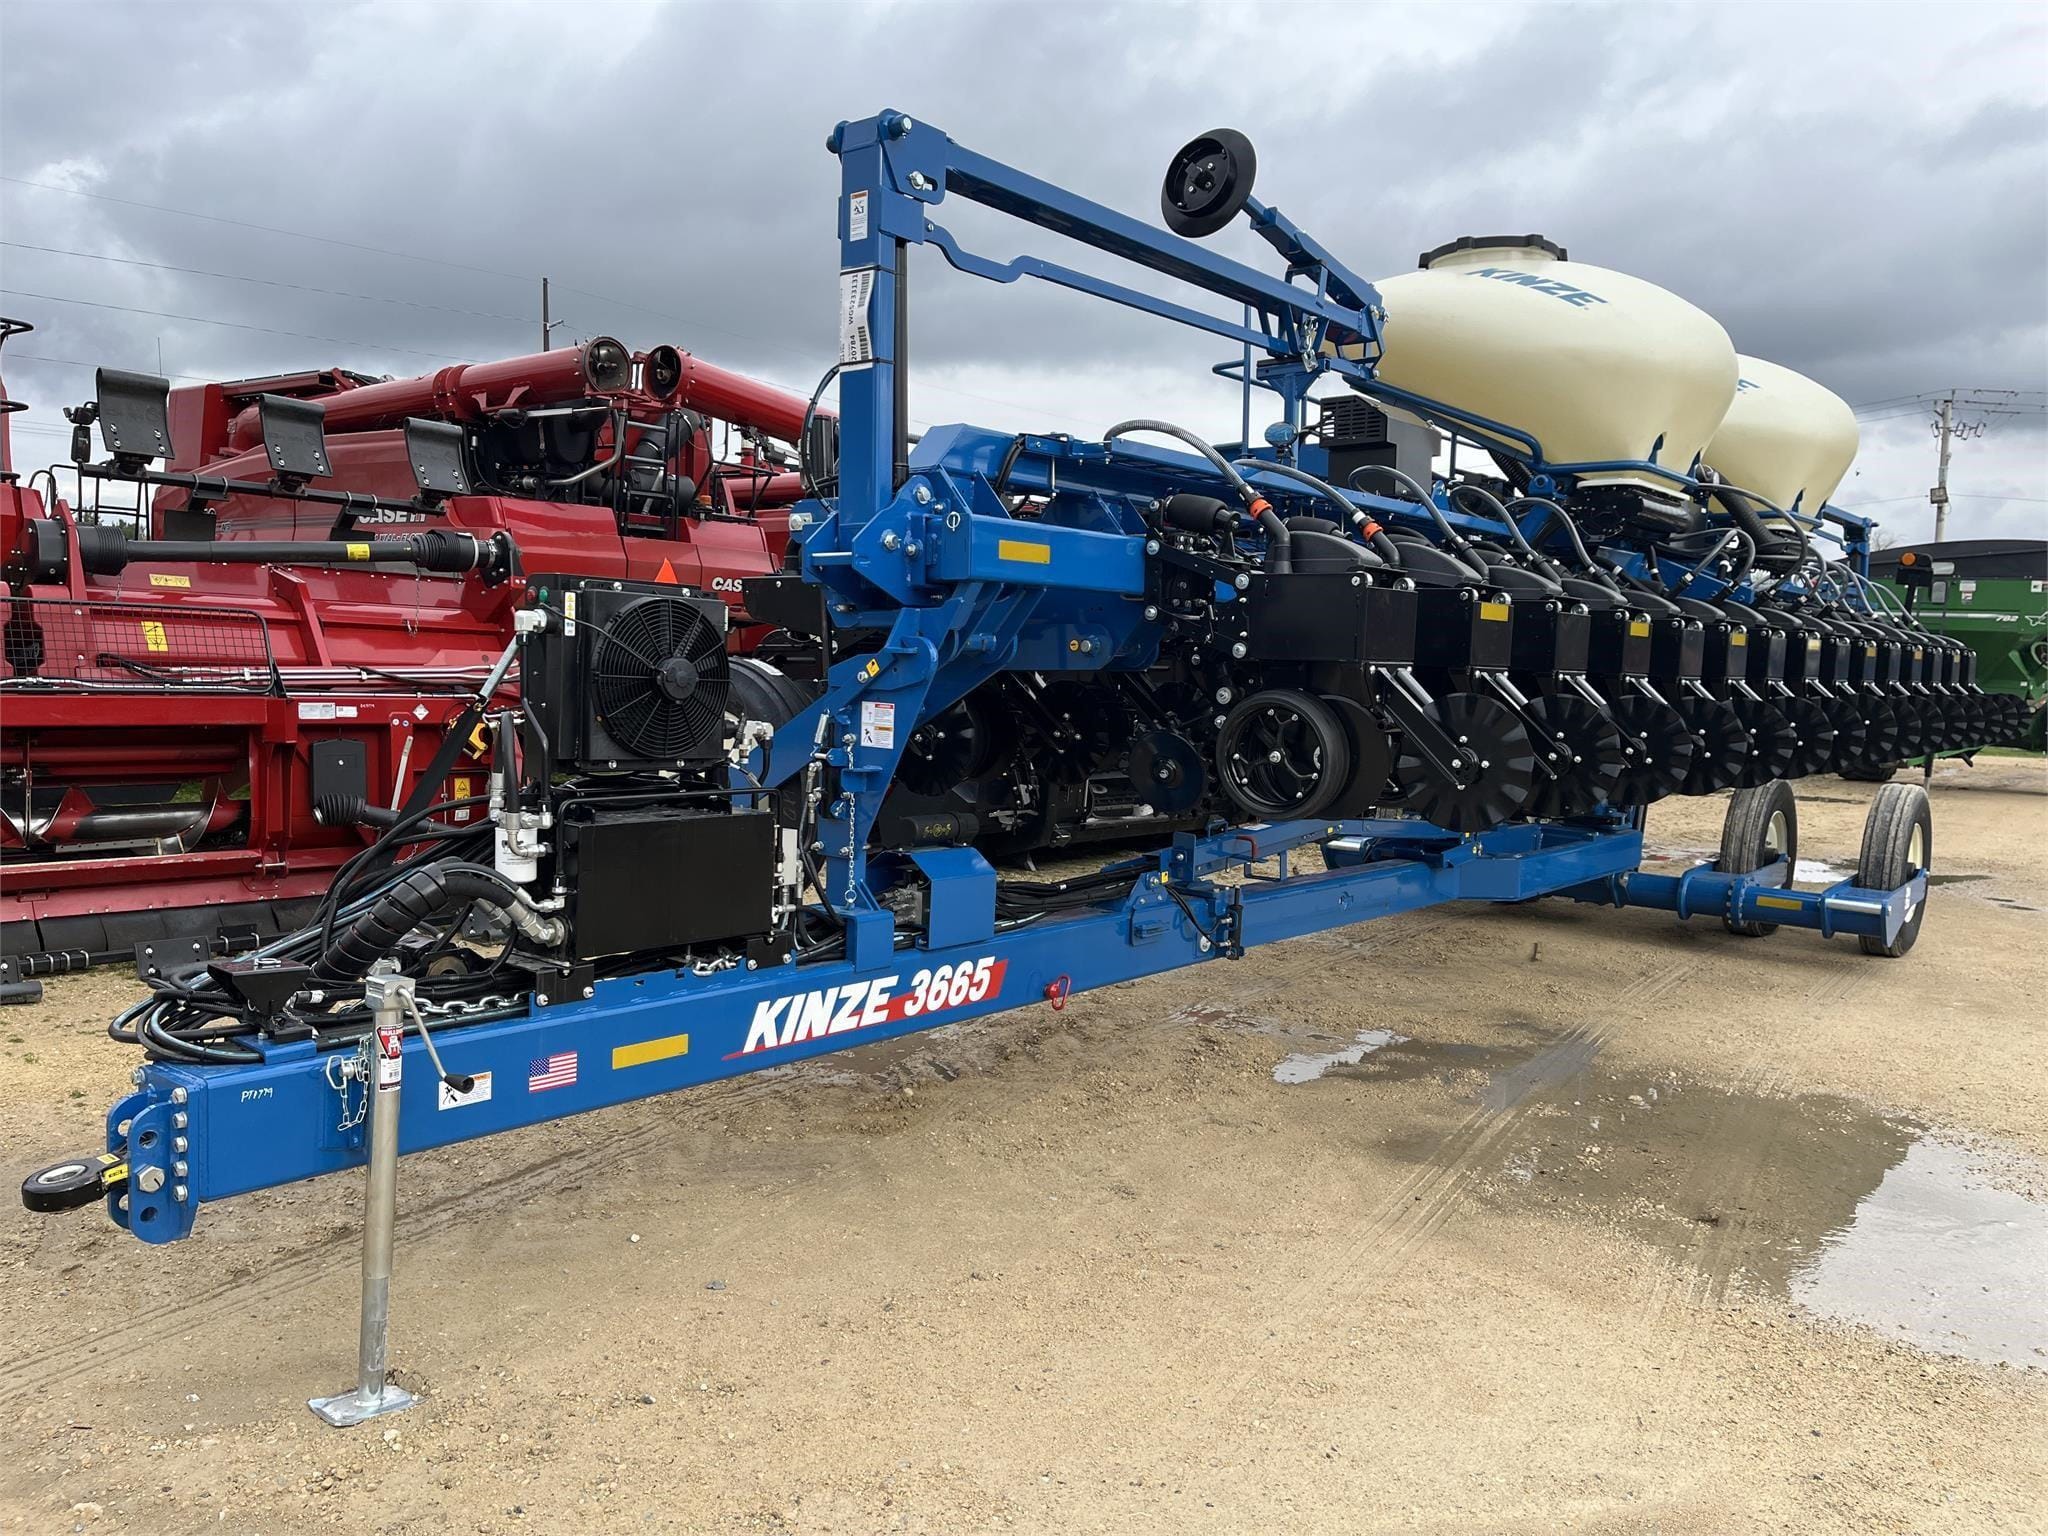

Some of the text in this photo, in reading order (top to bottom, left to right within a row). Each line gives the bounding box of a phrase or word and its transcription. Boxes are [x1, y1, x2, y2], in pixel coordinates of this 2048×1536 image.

[1464, 267, 1608, 307] KINZE
[711, 576, 743, 592] CAS
[743, 955, 996, 1054] KINZE 3665
